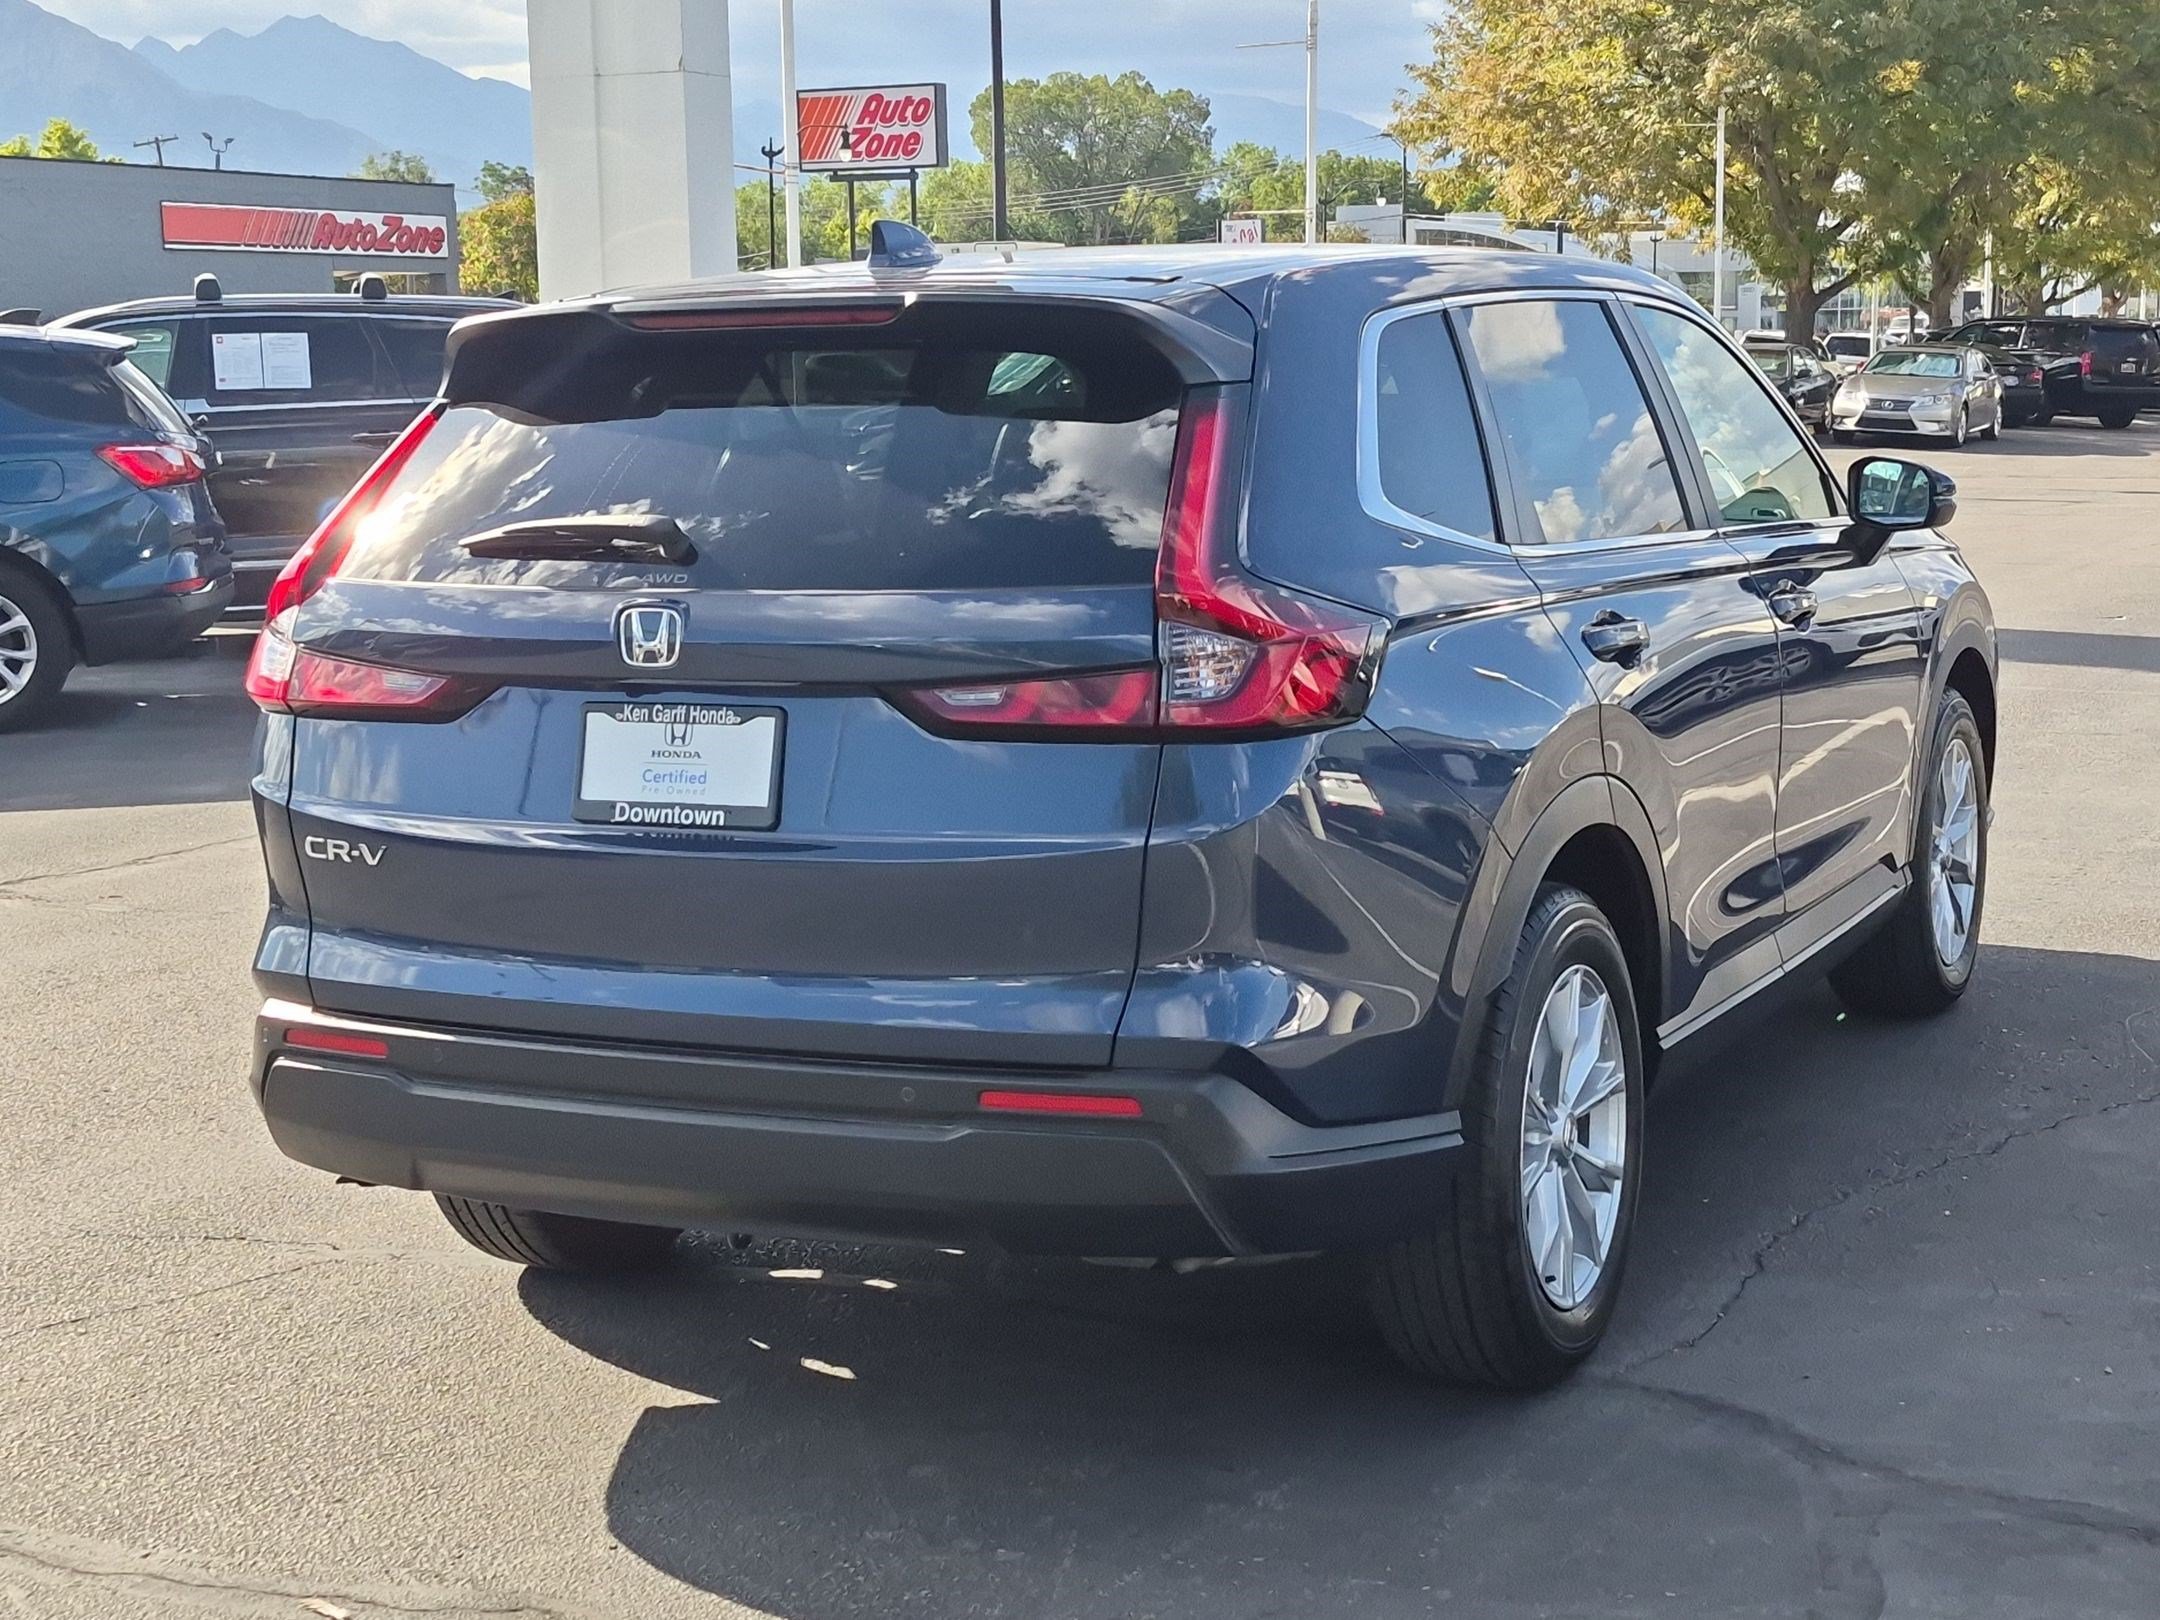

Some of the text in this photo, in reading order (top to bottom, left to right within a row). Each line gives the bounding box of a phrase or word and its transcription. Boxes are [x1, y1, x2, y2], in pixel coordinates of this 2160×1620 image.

[855, 92, 932, 127] Auto
[850, 126, 922, 160] Zone
[310, 212, 444, 254] AutoZone
[640, 573, 689, 585] AWD
[623, 704, 735, 725] Ken Garff Honda
[650, 749, 702, 760] HONDA
[642, 768, 708, 785] Certified
[611, 802, 726, 827] Downtown
[304, 835, 388, 866] CR-V
